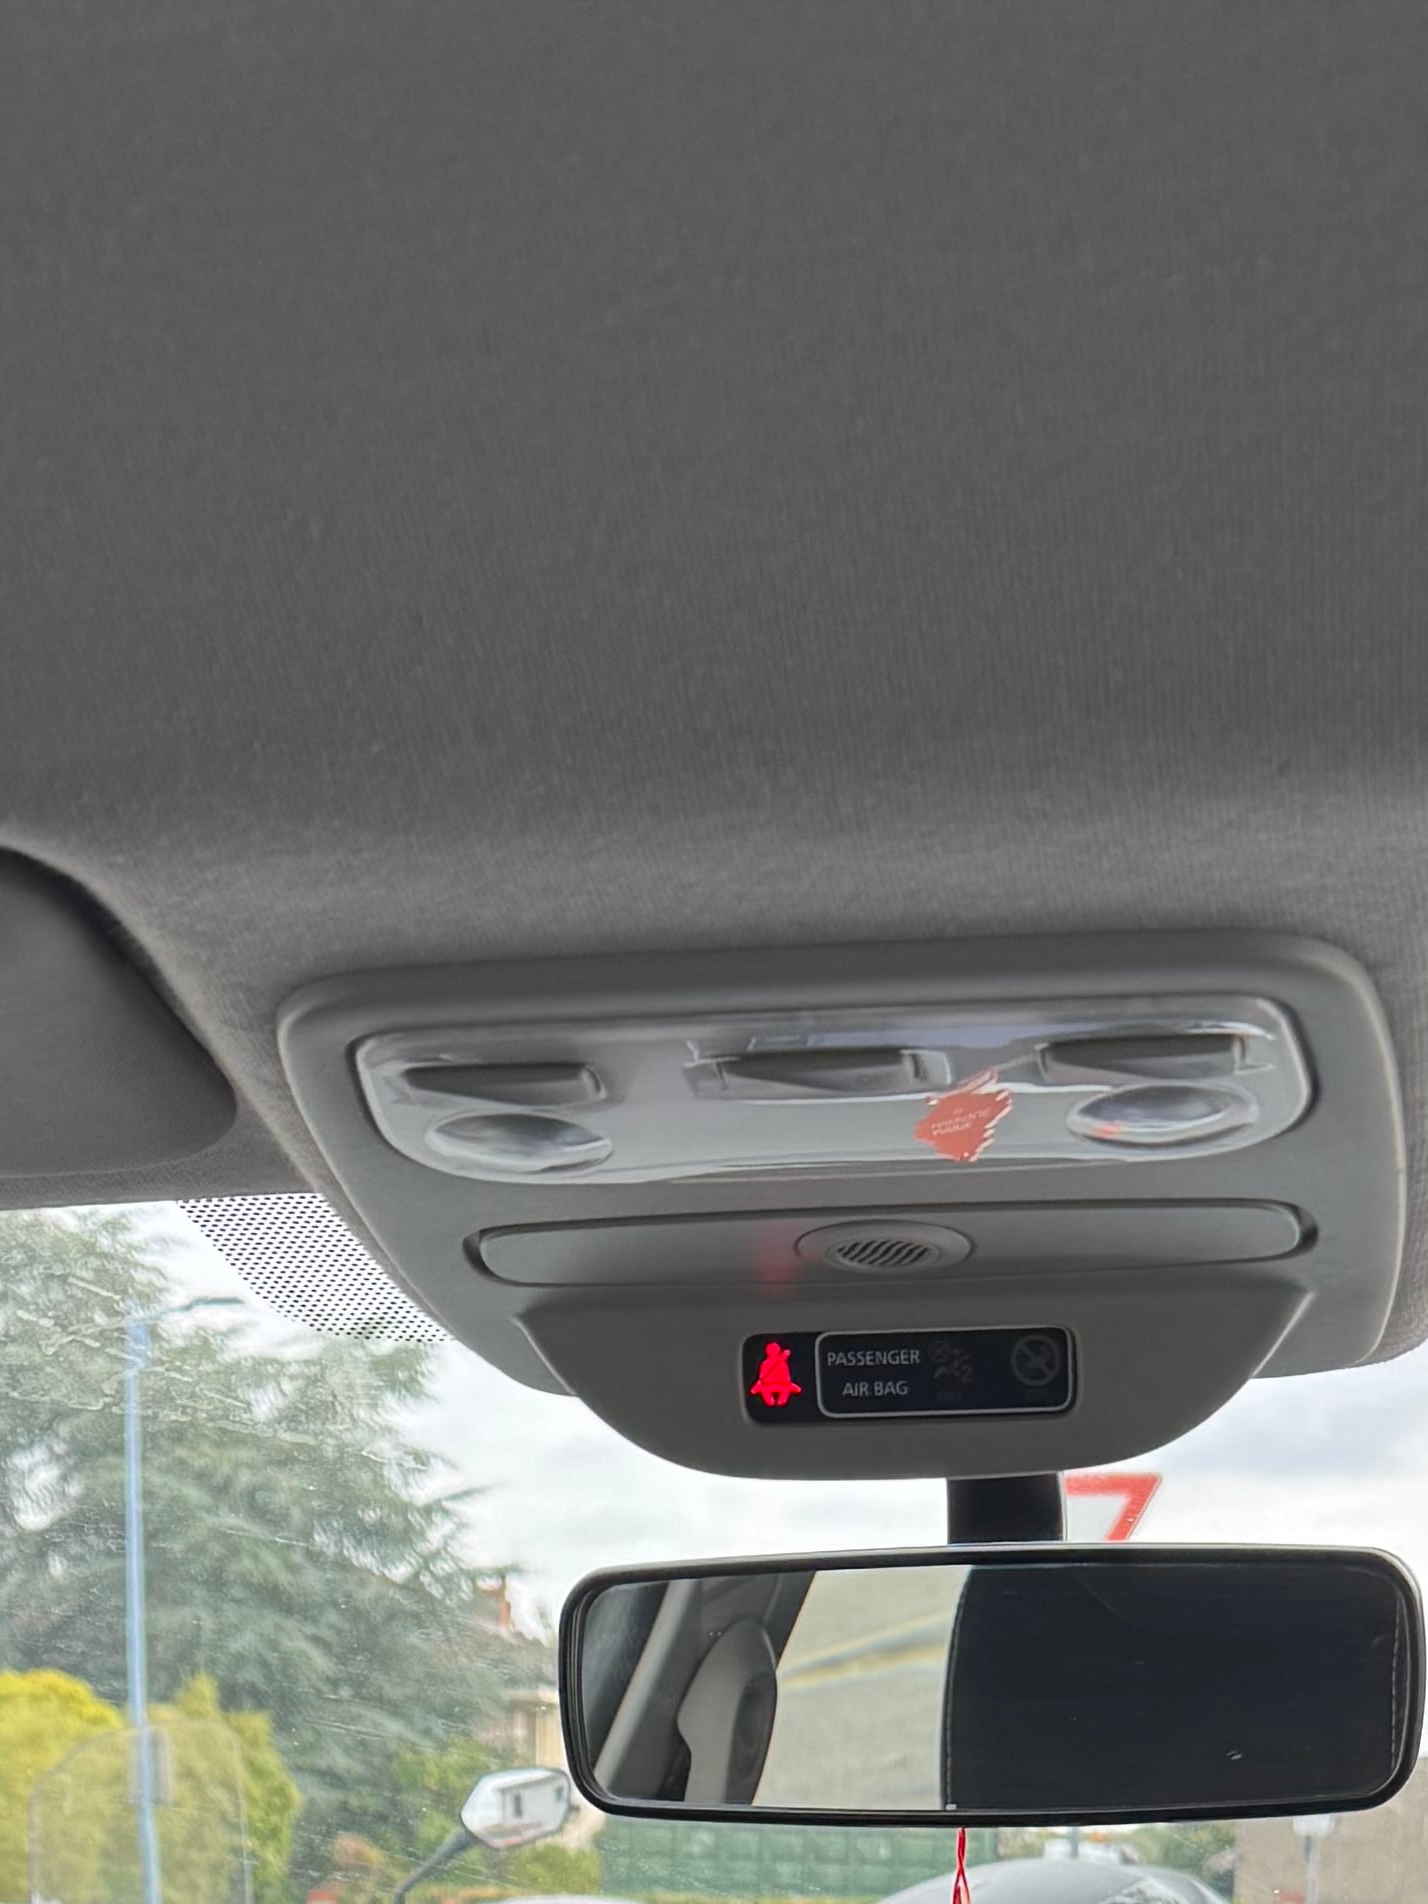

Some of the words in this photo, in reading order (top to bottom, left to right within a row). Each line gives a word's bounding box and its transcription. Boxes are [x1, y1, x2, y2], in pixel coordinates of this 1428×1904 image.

[827, 1349, 920, 1366] PASSENGER
[842, 1382, 869, 1397] AIR
[874, 1381, 908, 1396] BAG
